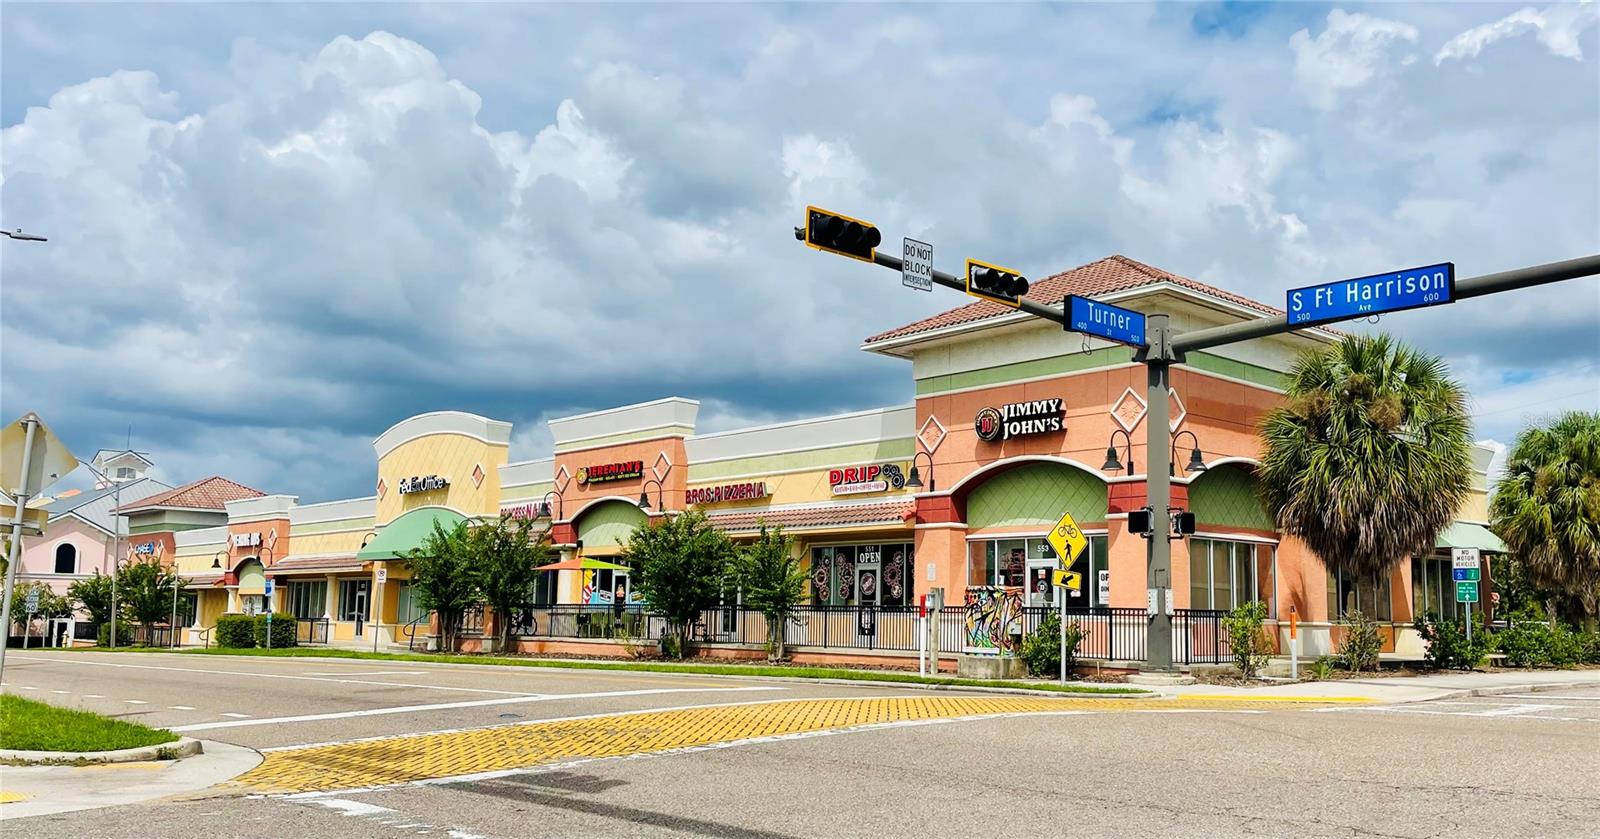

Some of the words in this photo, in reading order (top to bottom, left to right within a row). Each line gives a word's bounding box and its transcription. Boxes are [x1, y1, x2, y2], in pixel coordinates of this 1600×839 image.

[905, 244, 916, 257] DO
[917, 247, 931, 261] NOT
[904, 260, 931, 276] BLOCK
[904, 273, 931, 287] INTERSECTION
[1292, 291, 1303, 312] S
[1315, 287, 1334, 308] Ft
[1346, 271, 1445, 303] Harrison
[1423, 292, 1440, 302] 600
[1358, 303, 1372, 312] Ave
[1087, 302, 1131, 331] Turner
[1296, 312, 1311, 322] 500
[1002, 398, 1060, 422] JIMMY
[1003, 417, 1061, 440] JOHN'S
[829, 464, 880, 486] DRIP
[685, 487, 714, 505] BROS
[714, 481, 768, 503] PIZZERIA
[526, 501, 552, 520] NAIS
[860, 551, 881, 563] OPEN
[1037, 544, 1049, 553] 553
